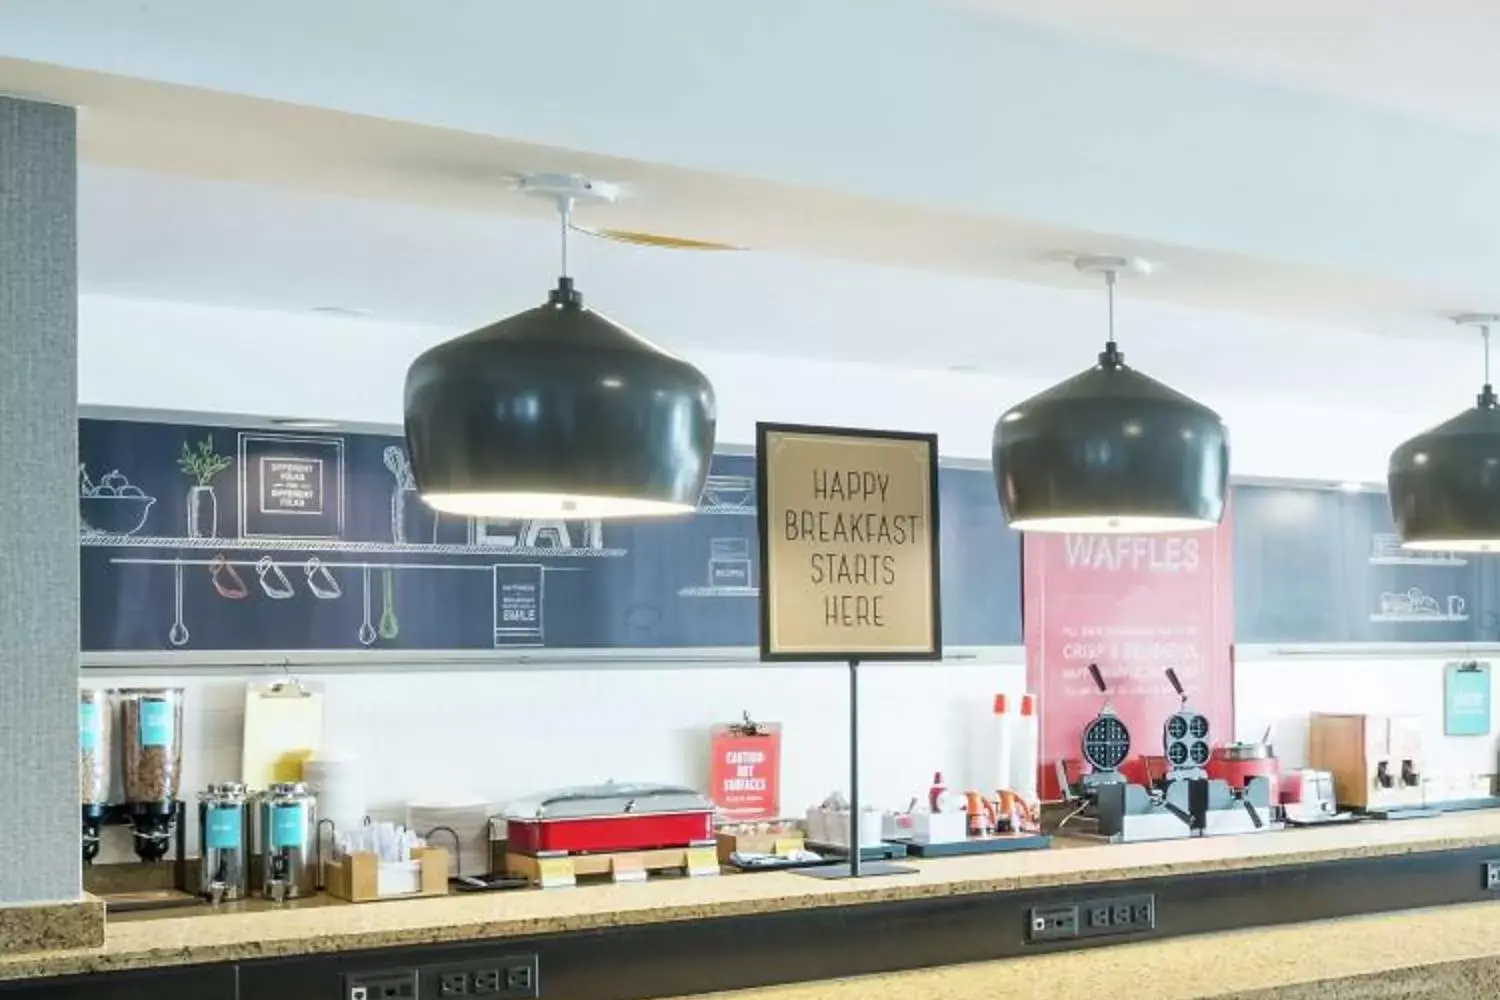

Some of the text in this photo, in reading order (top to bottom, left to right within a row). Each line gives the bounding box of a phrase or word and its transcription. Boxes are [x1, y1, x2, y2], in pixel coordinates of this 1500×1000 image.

[813, 469, 890, 502] HAPPY
[785, 509, 921, 545] BREAKFAST
[811, 553, 895, 585] STARTS
[1064, 533, 1200, 572] WAFFLES
[824, 595, 885, 627] HERE
